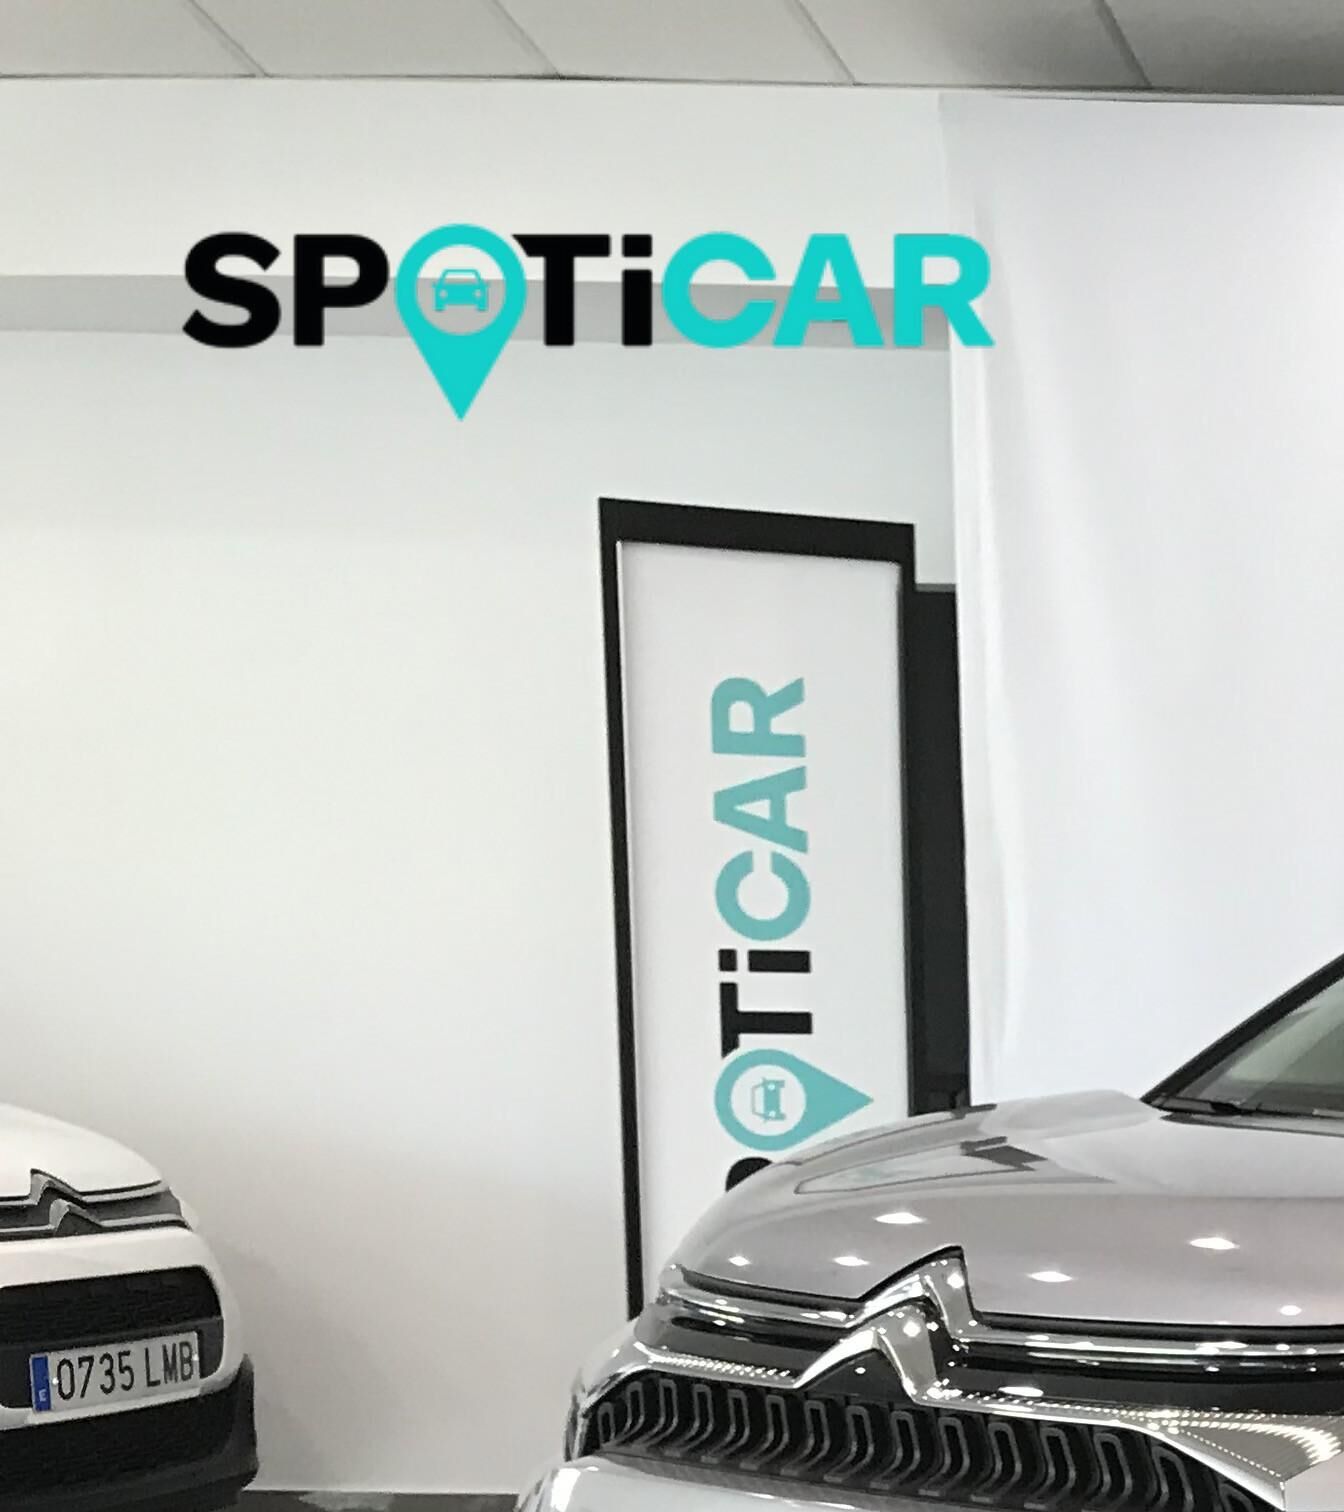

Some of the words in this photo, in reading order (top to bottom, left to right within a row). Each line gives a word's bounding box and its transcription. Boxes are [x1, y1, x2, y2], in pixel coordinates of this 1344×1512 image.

[711, 676, 874, 1193] OTiCAR
[38, 1388, 48, 1402] E
[56, 1350, 135, 1400] 0735
[144, 1341, 194, 1388] LMB
